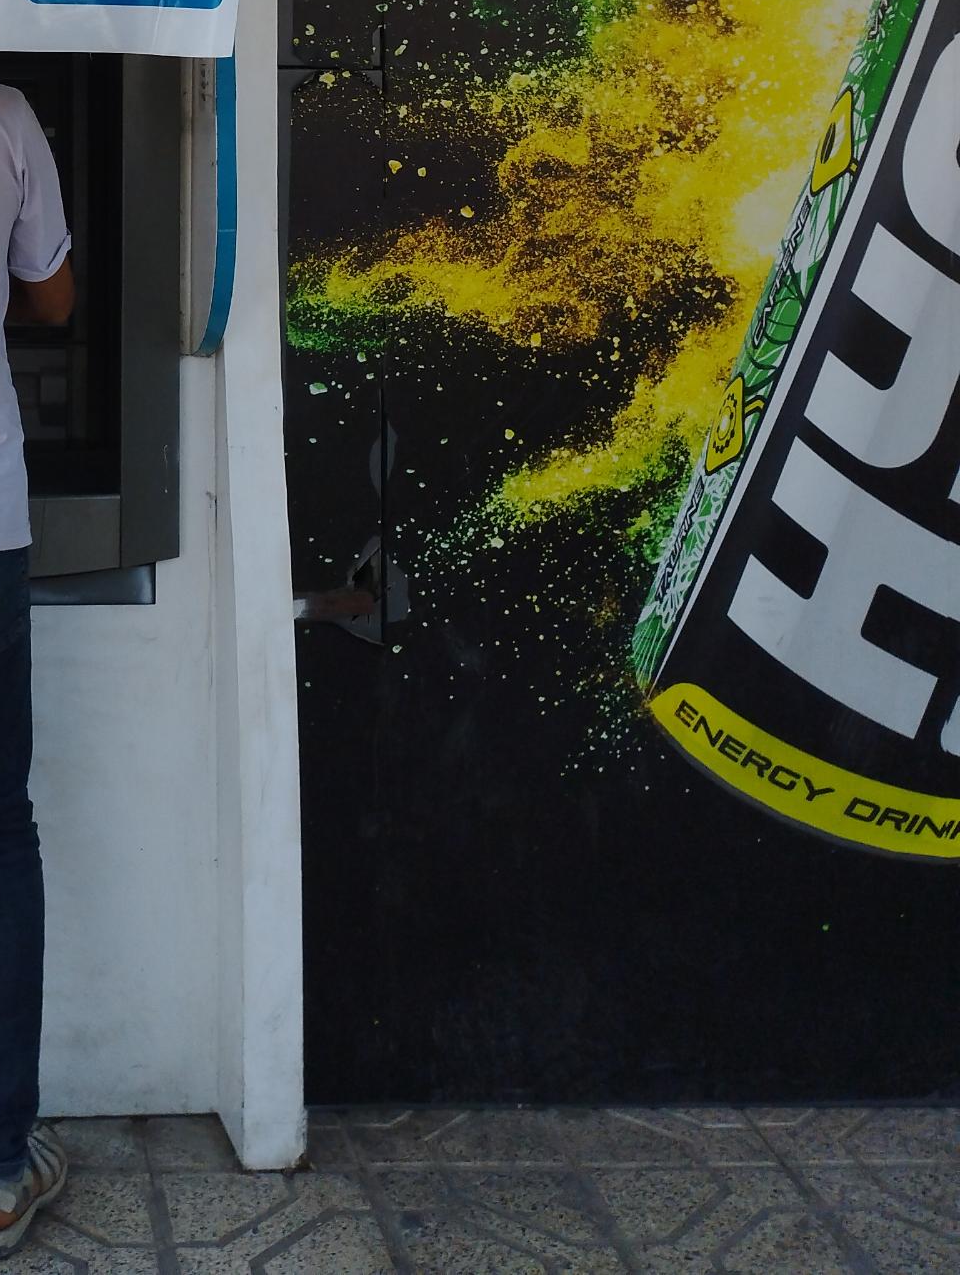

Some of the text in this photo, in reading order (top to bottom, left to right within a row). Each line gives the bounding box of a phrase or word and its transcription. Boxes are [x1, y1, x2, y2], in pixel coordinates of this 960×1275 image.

[753, 195, 811, 349] CAFFEINE
[655, 476, 704, 604] TAURINE
[673, 699, 835, 802] ENERGY
